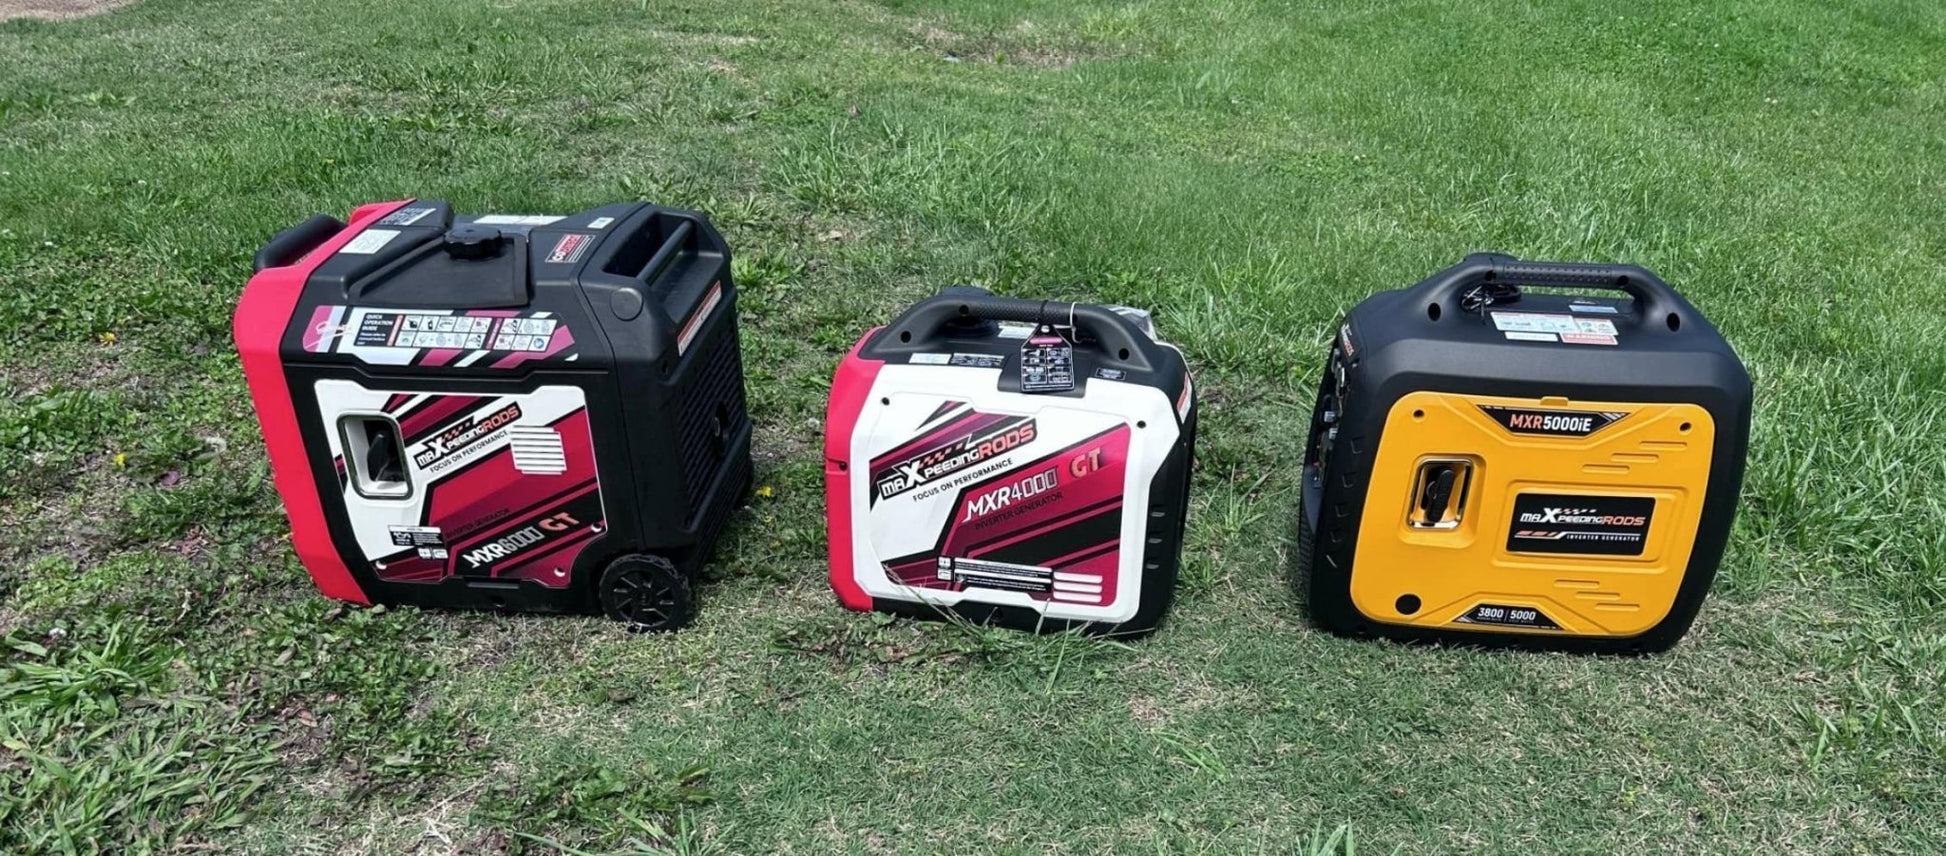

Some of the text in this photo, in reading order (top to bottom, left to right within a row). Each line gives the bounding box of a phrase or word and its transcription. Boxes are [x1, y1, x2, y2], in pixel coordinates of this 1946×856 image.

[1509, 413, 1593, 432] MXR5000iE
[429, 429, 508, 473] FOCUS ON PERFORMANCE
[912, 457, 1013, 502] FOCUS ON PERFORMANCE
[961, 447, 1104, 523] MXR4000 GT
[974, 491, 1064, 530] INVERTER GENERATOR
[462, 525, 545, 569] MXR6000
[538, 511, 580, 532] GT
[1601, 534, 1640, 542] GENERATOR
[1477, 607, 1505, 619] 3800
[1509, 609, 1537, 621] 5000
